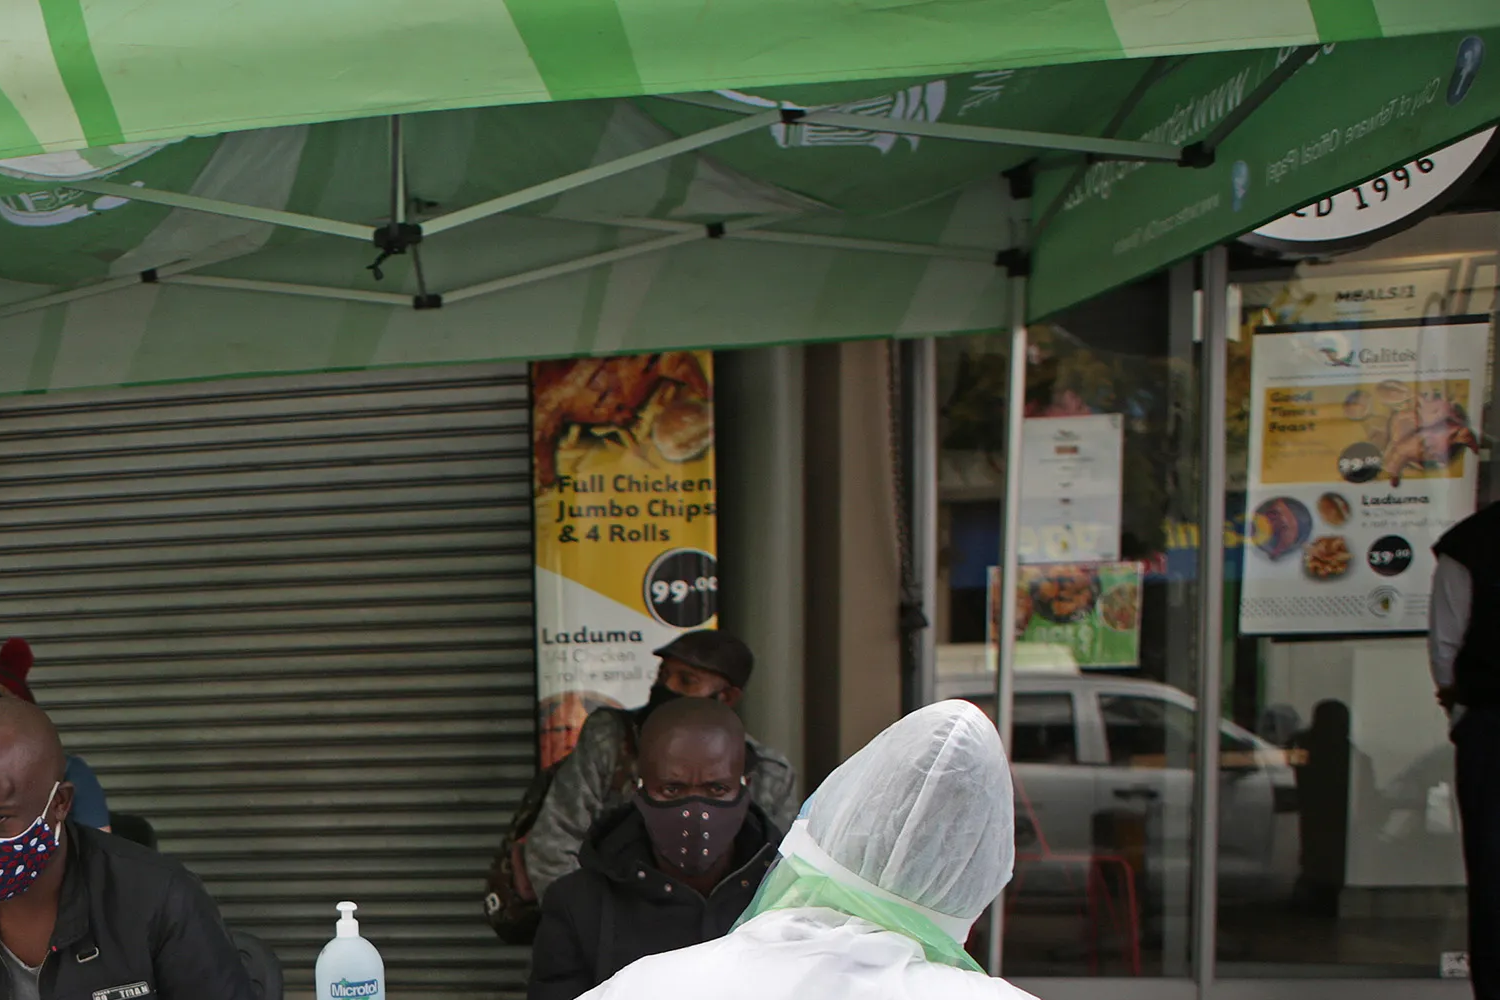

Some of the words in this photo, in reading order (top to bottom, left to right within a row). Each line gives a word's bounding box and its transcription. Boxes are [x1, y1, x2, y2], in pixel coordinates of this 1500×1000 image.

[1353, 158, 1435, 211] 1996
[1269, 422, 1316, 432] Feast
[556, 474, 604, 493] Full
[613, 474, 712, 493] Chicken
[1361, 494, 1430, 506] Laduma
[555, 499, 640, 522] Jumbo
[648, 499, 717, 522] Chips
[558, 525, 579, 543] &
[585, 526, 601, 542] 4
[610, 524, 671, 543] Rolls
[542, 626, 644, 645] Laduma
[331, 981, 378, 997] Microtol
